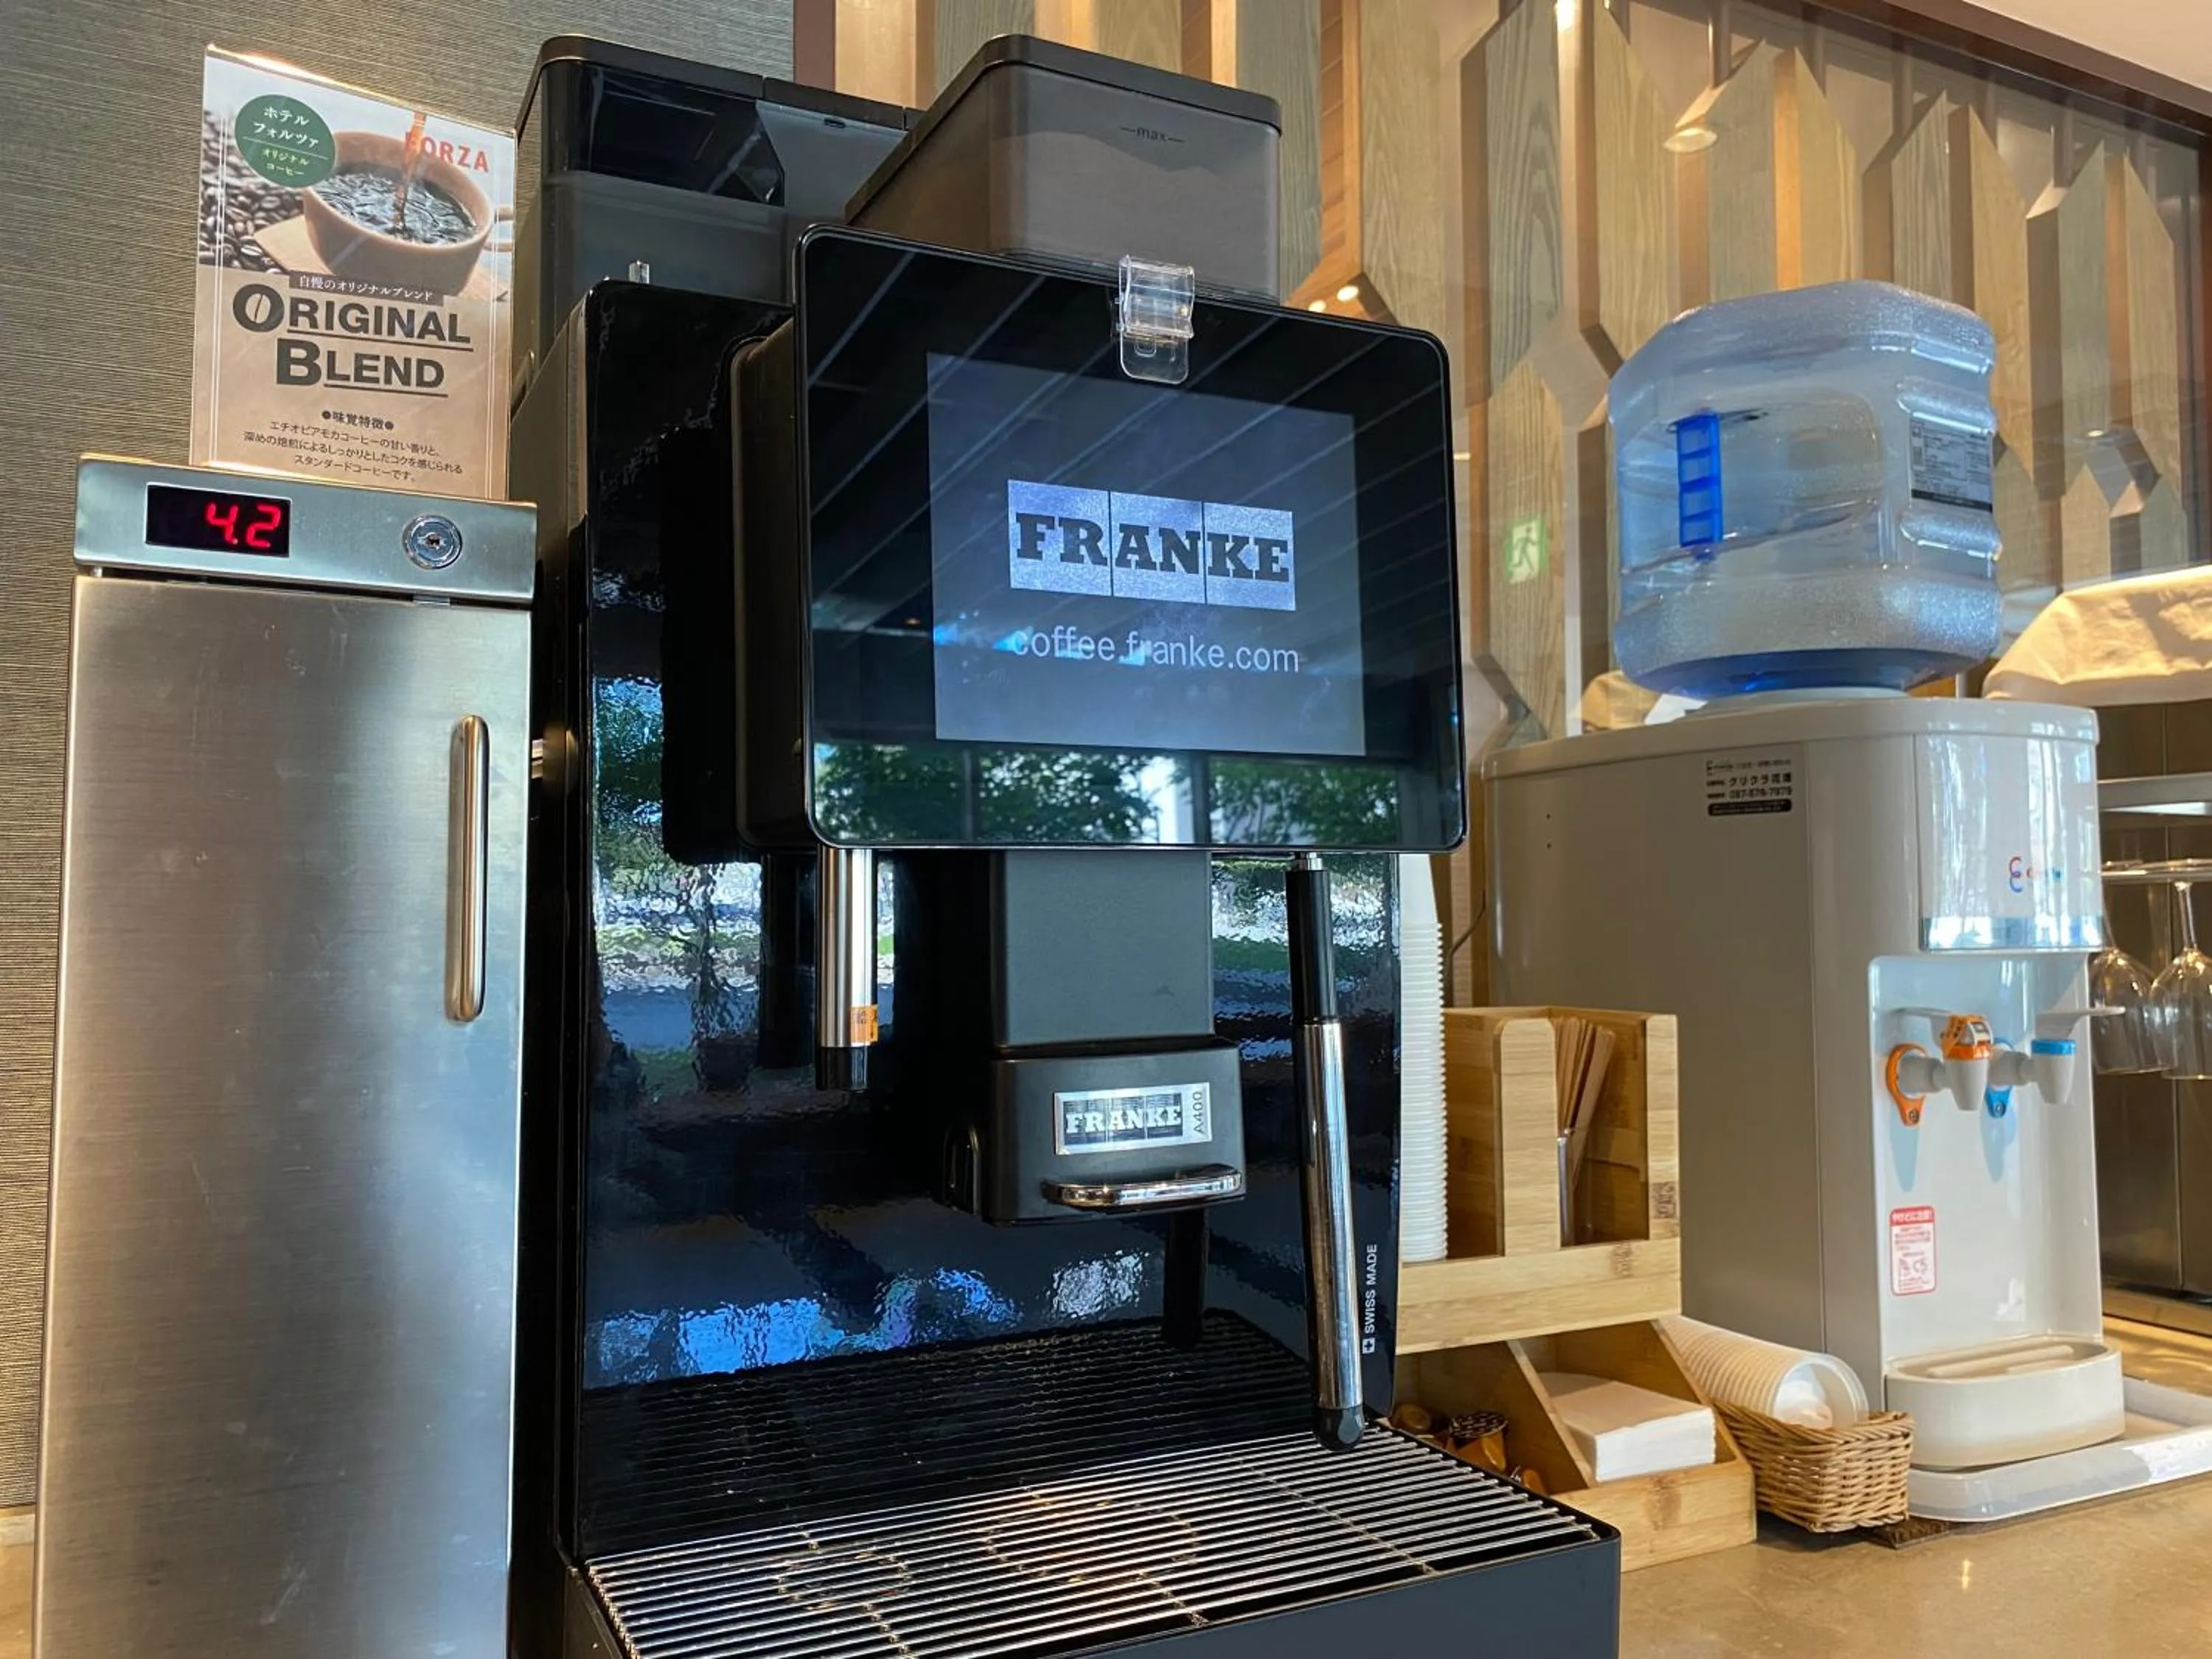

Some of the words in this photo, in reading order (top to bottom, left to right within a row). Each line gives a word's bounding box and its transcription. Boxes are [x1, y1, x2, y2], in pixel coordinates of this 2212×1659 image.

[253, 121, 319, 148] フォルツァ
[263, 106, 310, 125] ホテル
[262, 148, 310, 166] オリジナル
[266, 163, 305, 176] コーヒー
[299, 275, 434, 302] 自慢のオリジナルブレンド
[232, 284, 471, 344] ORIGINAL
[276, 338, 445, 389] BLEND
[206, 502, 282, 548] 4.2
[1016, 512, 1289, 582] FRANKE
[1013, 625, 1299, 672] coffee.franke.com
[1066, 1106, 1181, 1133] FRANKE
[1192, 1091, 1205, 1134] A400
[1366, 1245, 1377, 1285] MADE
[1365, 1290, 1376, 1334] SWISS
